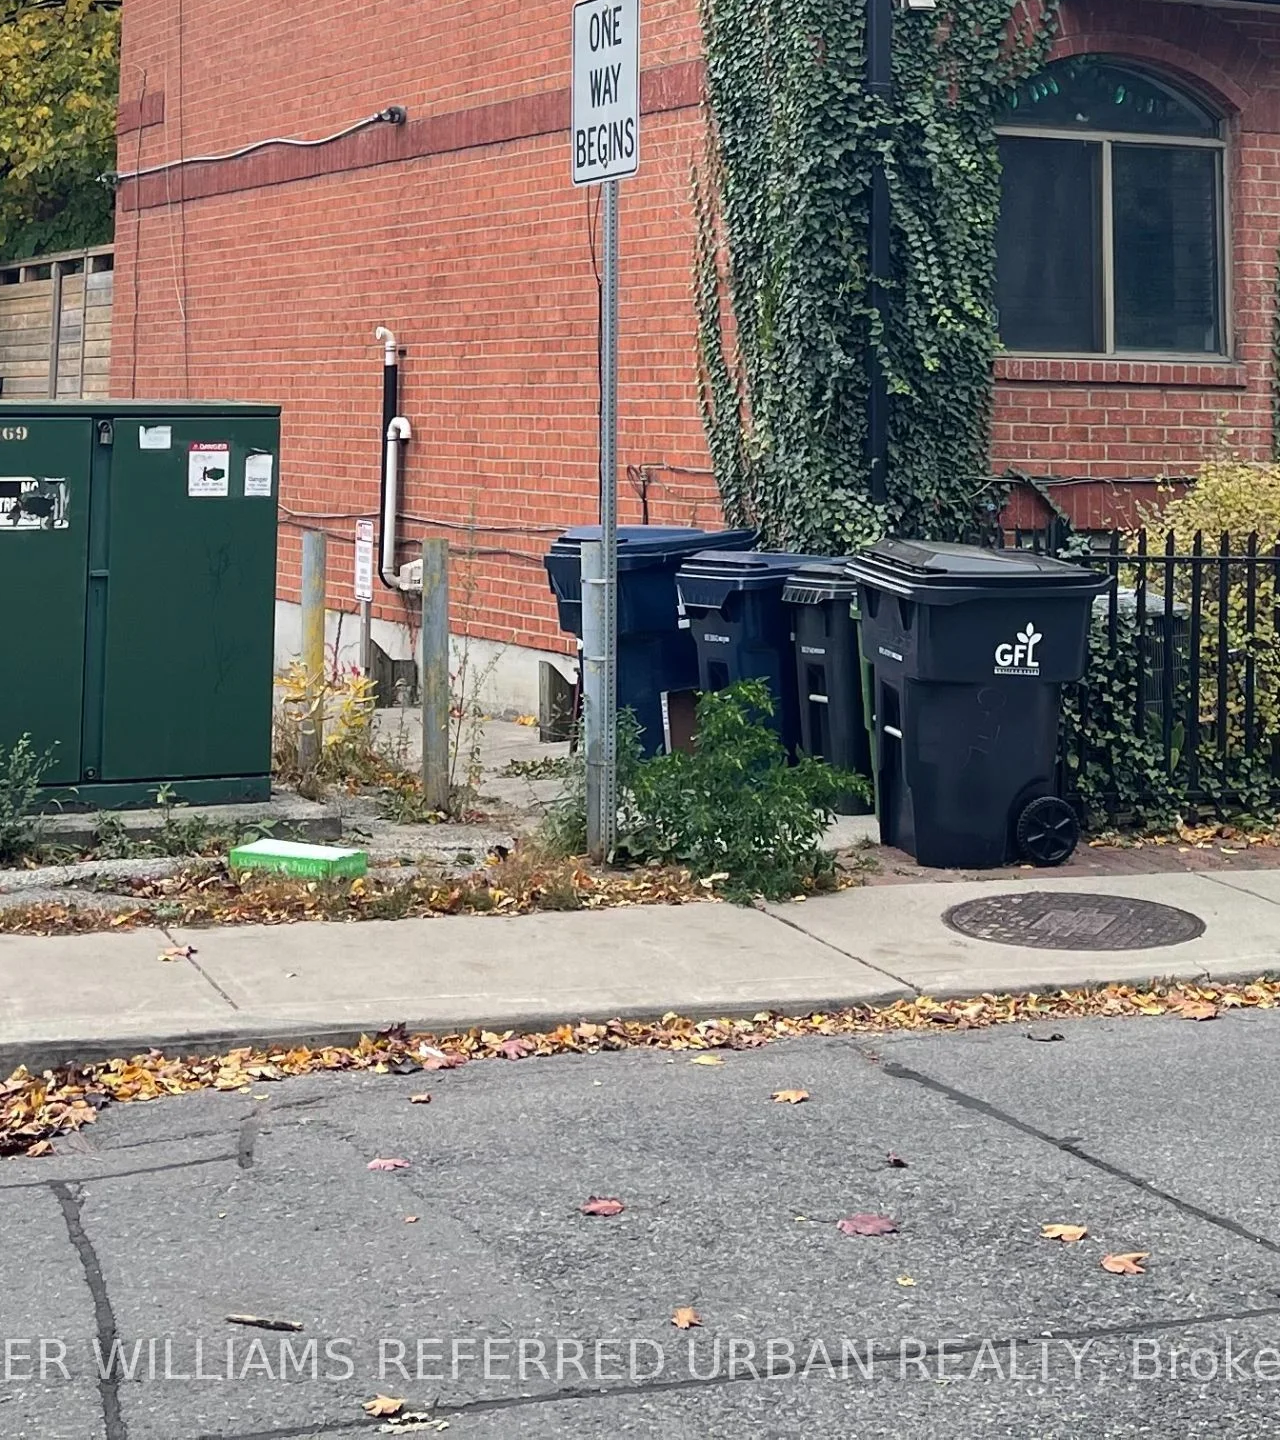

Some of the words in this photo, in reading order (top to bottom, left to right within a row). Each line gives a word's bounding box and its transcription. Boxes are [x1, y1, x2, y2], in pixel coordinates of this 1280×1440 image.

[589, 5, 622, 52] ONE
[589, 62, 621, 108] WAY
[576, 117, 634, 168] BEGINS
[995, 638, 1040, 667] GFL
